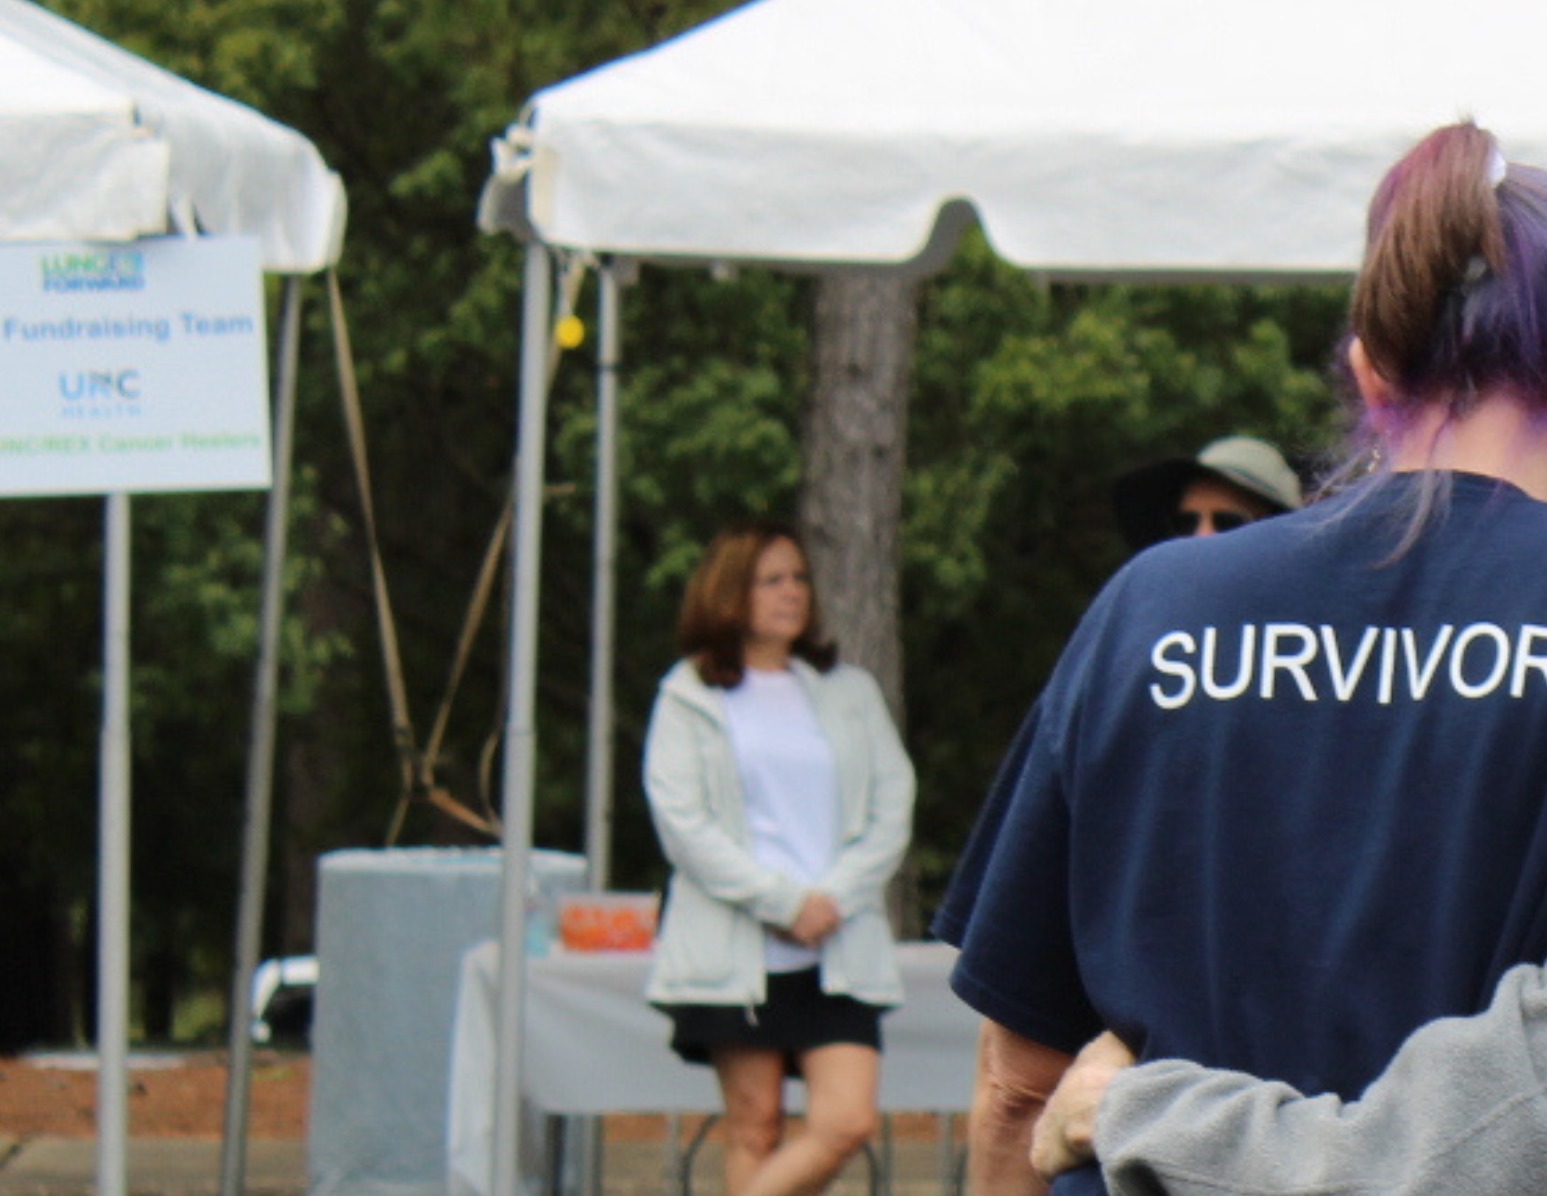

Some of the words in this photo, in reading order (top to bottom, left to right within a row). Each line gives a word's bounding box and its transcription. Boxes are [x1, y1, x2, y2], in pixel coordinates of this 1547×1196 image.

[4, 316, 171, 342] Fundraising
[181, 312, 254, 335] Team
[58, 370, 141, 401] UNC
